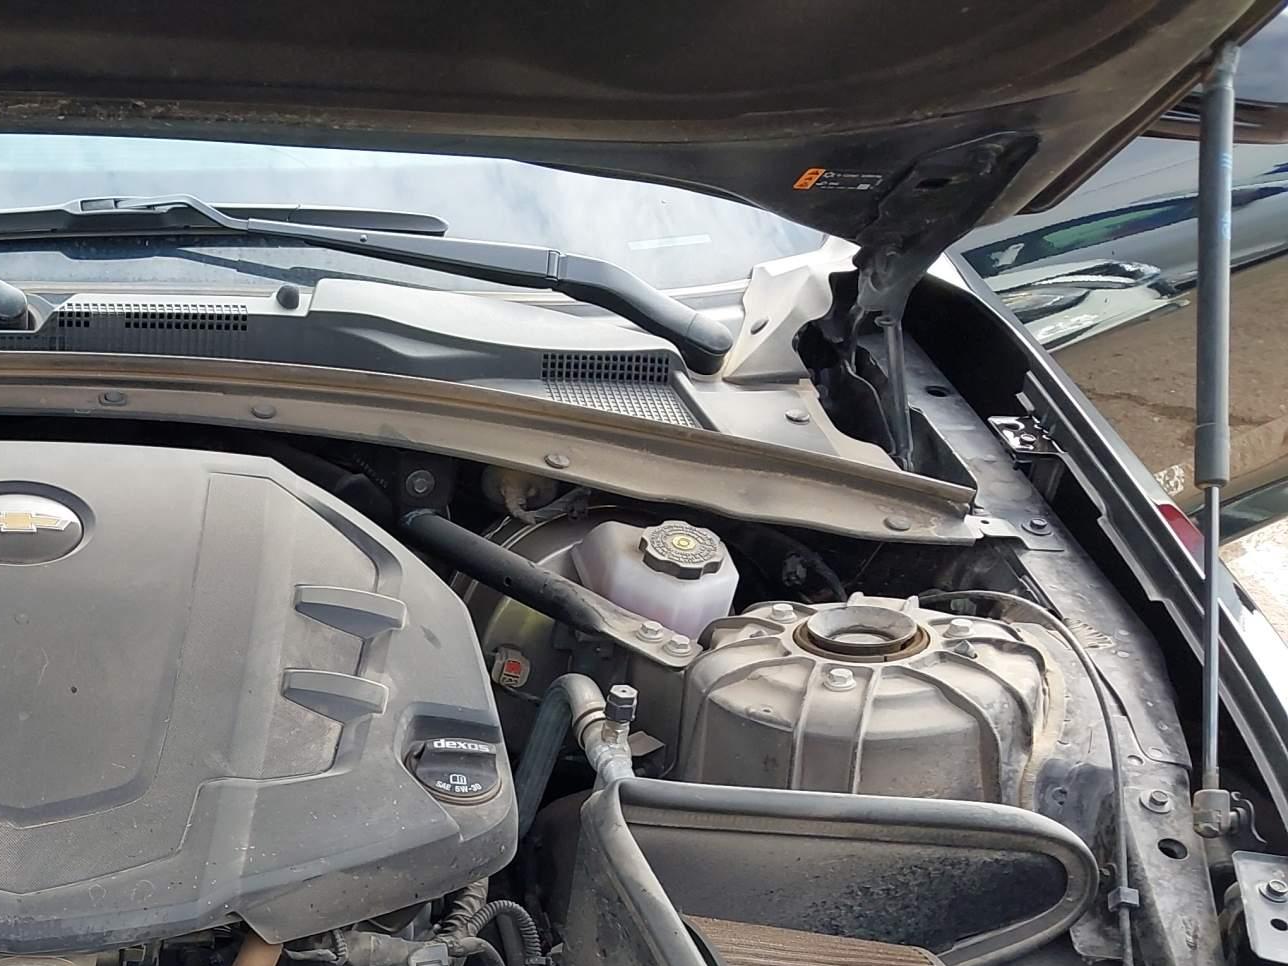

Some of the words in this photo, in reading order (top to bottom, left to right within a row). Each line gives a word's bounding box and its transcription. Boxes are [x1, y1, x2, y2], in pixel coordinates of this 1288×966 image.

[433, 739, 490, 752] dexos
[435, 780, 452, 791] SAE
[455, 783, 482, 793] 5W-30
